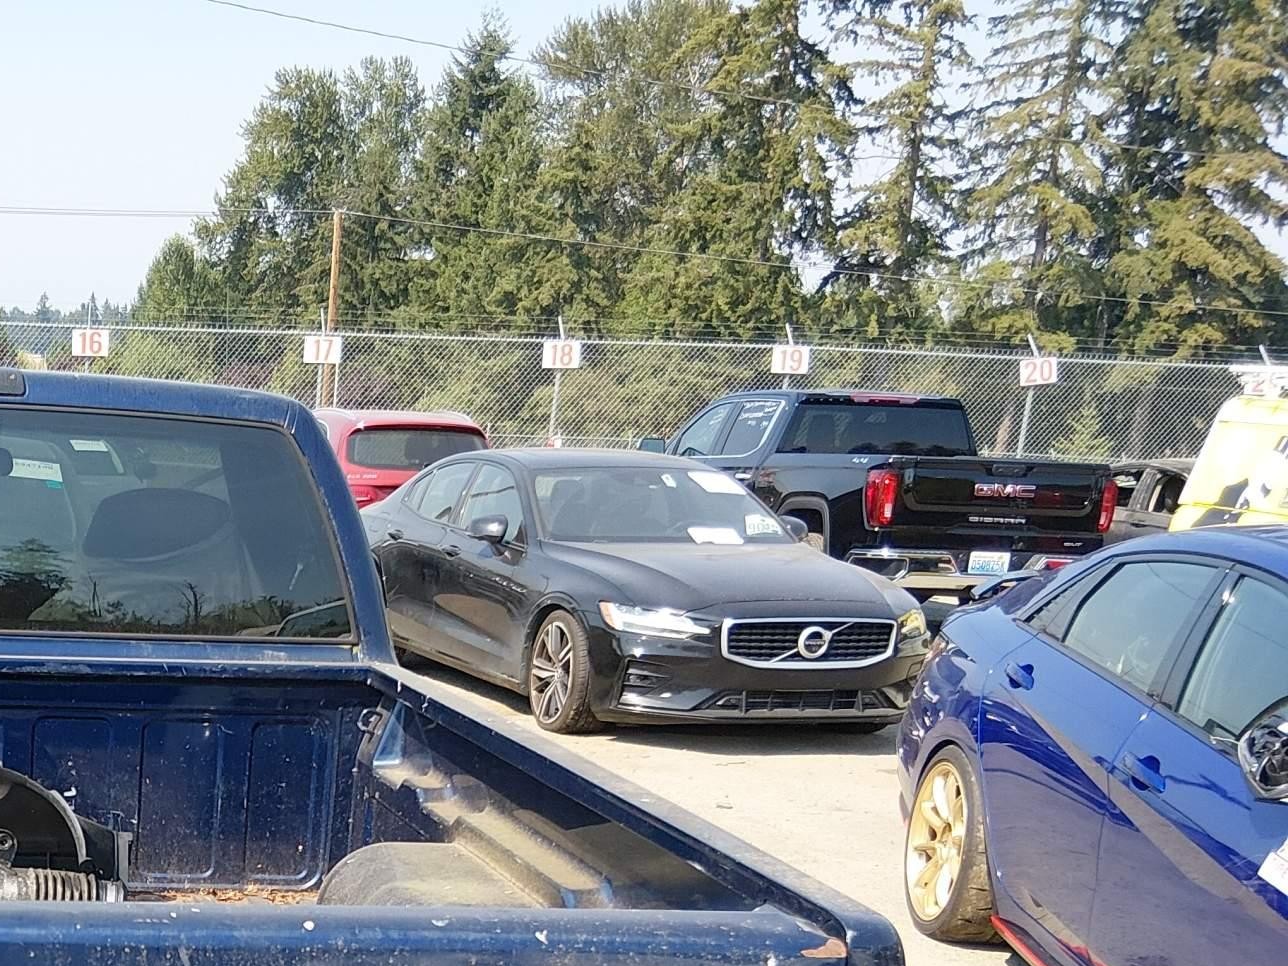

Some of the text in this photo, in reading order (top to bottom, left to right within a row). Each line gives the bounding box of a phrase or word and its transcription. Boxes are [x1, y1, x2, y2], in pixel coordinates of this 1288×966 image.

[79, 331, 102, 354] 16
[314, 339, 333, 361] 17
[551, 344, 572, 366] 18
[780, 349, 802, 371] 19
[1024, 360, 1052, 383] 20
[974, 483, 1037, 498] GMC
